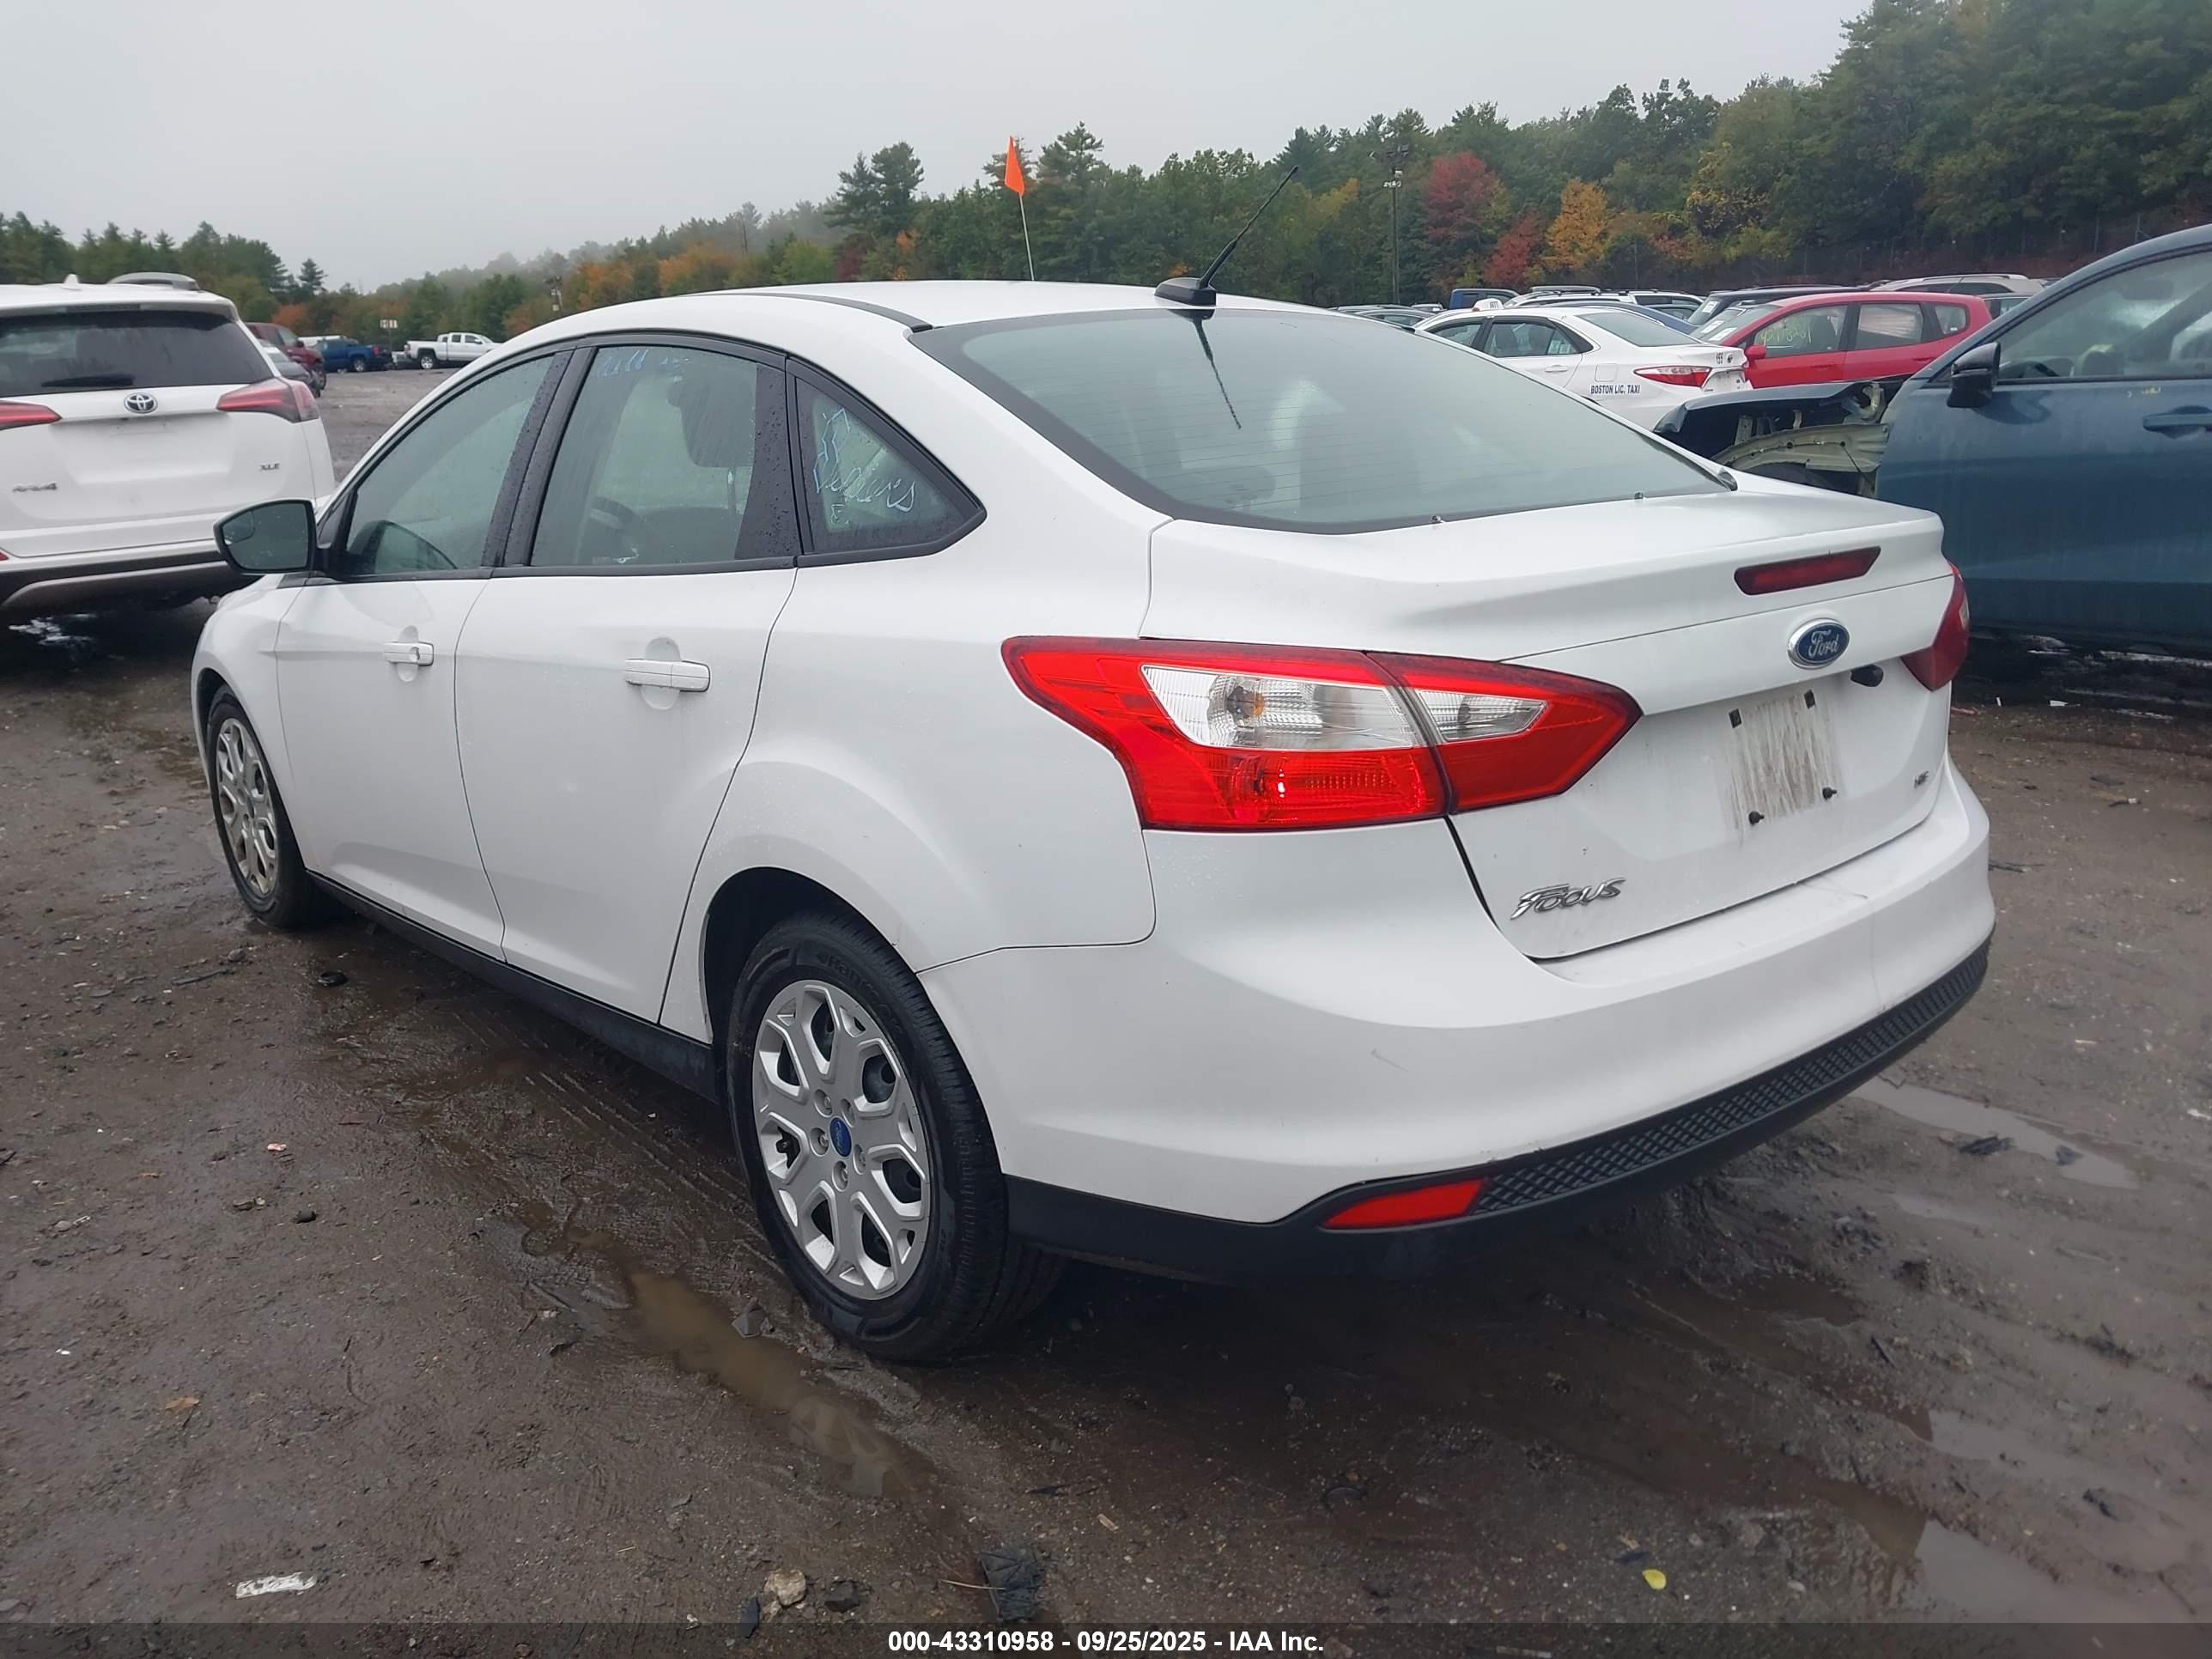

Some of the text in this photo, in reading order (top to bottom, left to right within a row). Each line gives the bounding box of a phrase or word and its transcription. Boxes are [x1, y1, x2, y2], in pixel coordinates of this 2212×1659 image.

[1590, 384, 1641, 394] BOSTON LIC. TAXI
[1808, 629, 1839, 659] Ford
